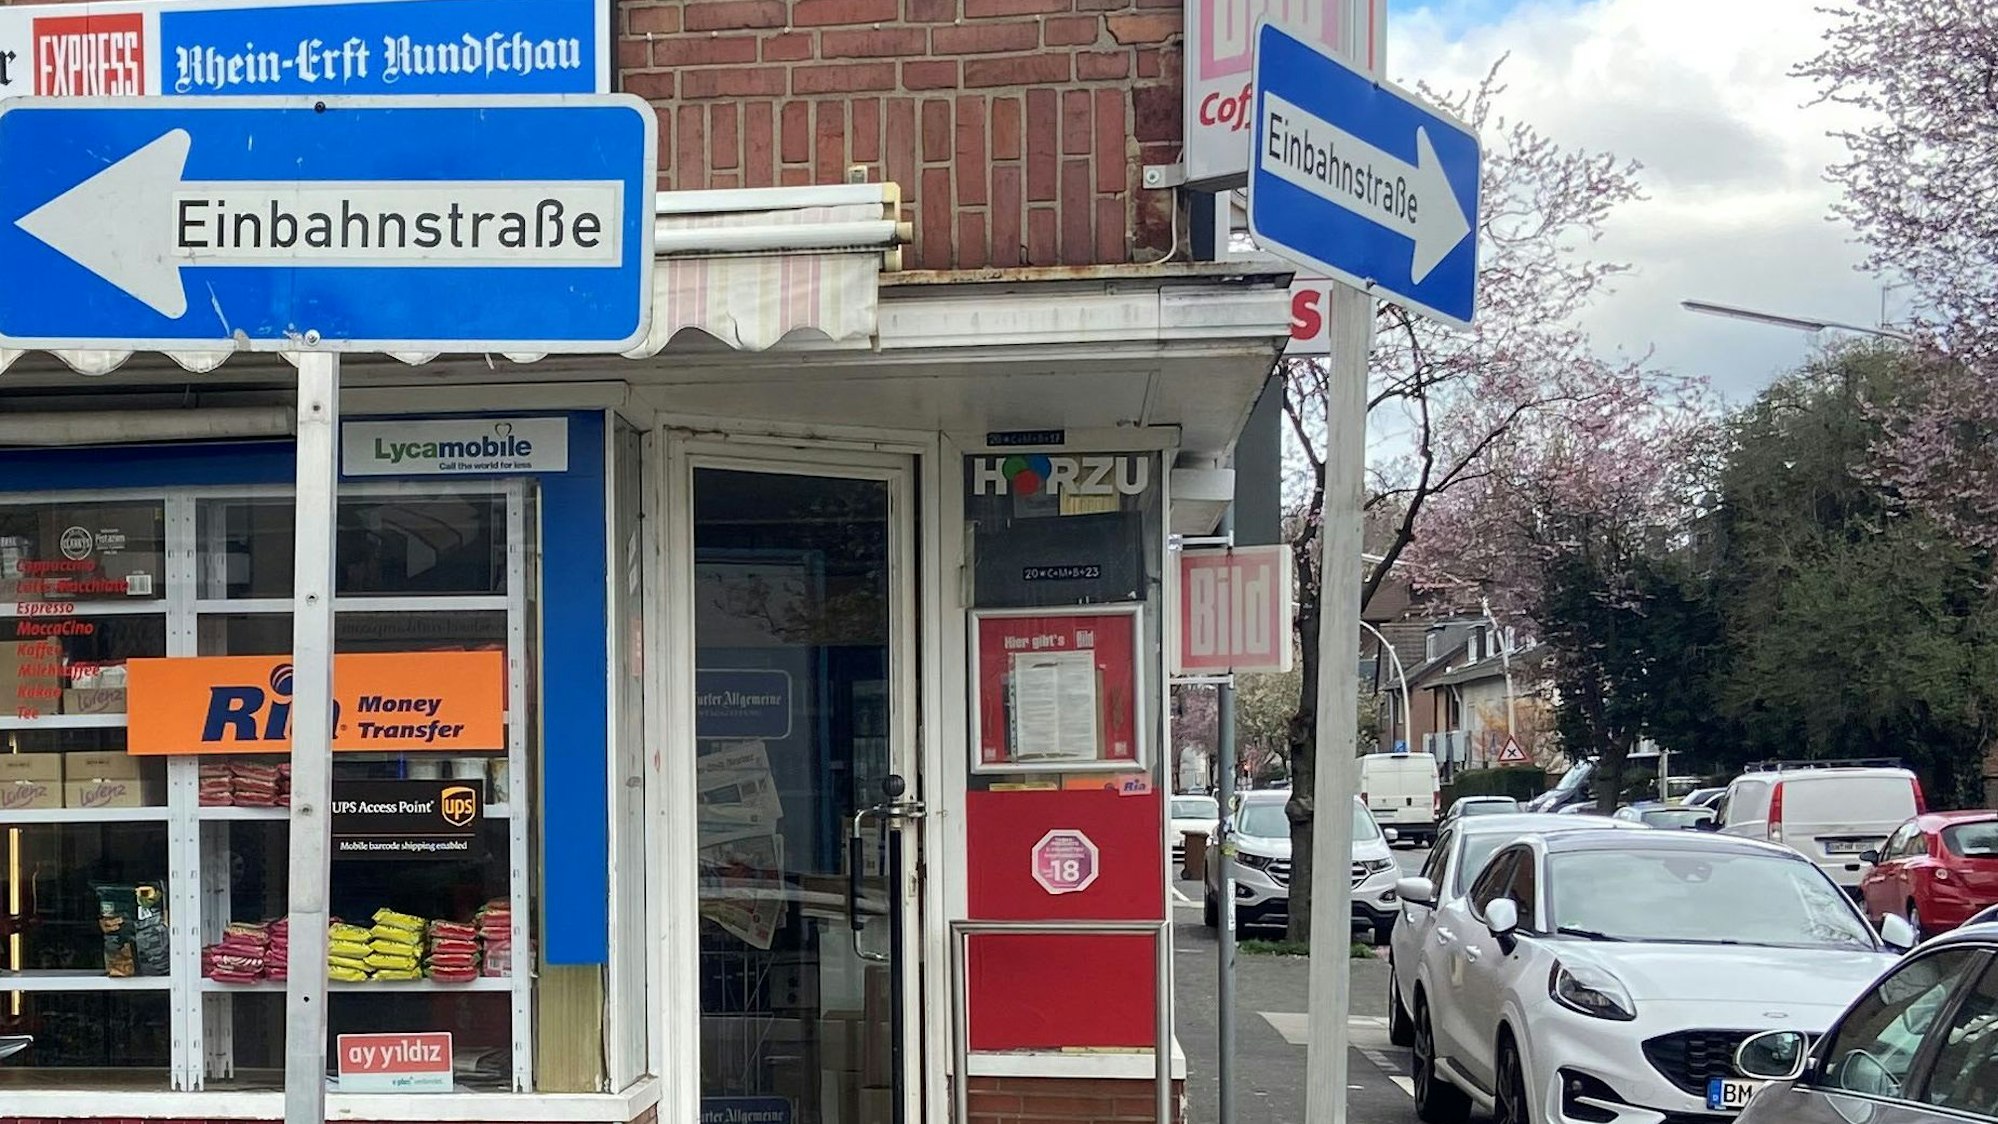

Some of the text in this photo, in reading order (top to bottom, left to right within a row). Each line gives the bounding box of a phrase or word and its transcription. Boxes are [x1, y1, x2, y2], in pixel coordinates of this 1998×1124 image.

[39, 31, 138, 96] EXPRESS
[174, 31, 581, 93] Rhein-Erft Rundschau
[1200, 82, 1252, 132] Cof
[1267, 112, 1418, 225] Einbahnstraße
[178, 198, 602, 249] Einbahnstraße
[374, 434, 532, 463] Lycamobile
[439, 461, 532, 471] Call the world for less
[16, 560, 96, 576] Cappuccino
[16, 602, 74, 616] Espresso
[1190, 565, 1271, 656] Bild
[16, 620, 94, 635] MoccaCino
[1004, 630, 1095, 649] Hier gibt's Bild
[16, 641, 63, 659] Kaffee
[17, 662, 100, 680] Milchkaffee
[16, 684, 62, 698] Kakao
[17, 706, 40, 719] Tee
[358, 696, 442, 716] Money
[358, 720, 465, 742] Transfer
[1123, 778, 1147, 792] Ria
[332, 801, 356, 813] UPS
[358, 801, 397, 814] Access
[444, 799, 473, 820] ups
[340, 841, 468, 852] Mobile barcode shipping enabled
[348, 1046, 376, 1069] ay
[1723, 1083, 1753, 1103] BM
